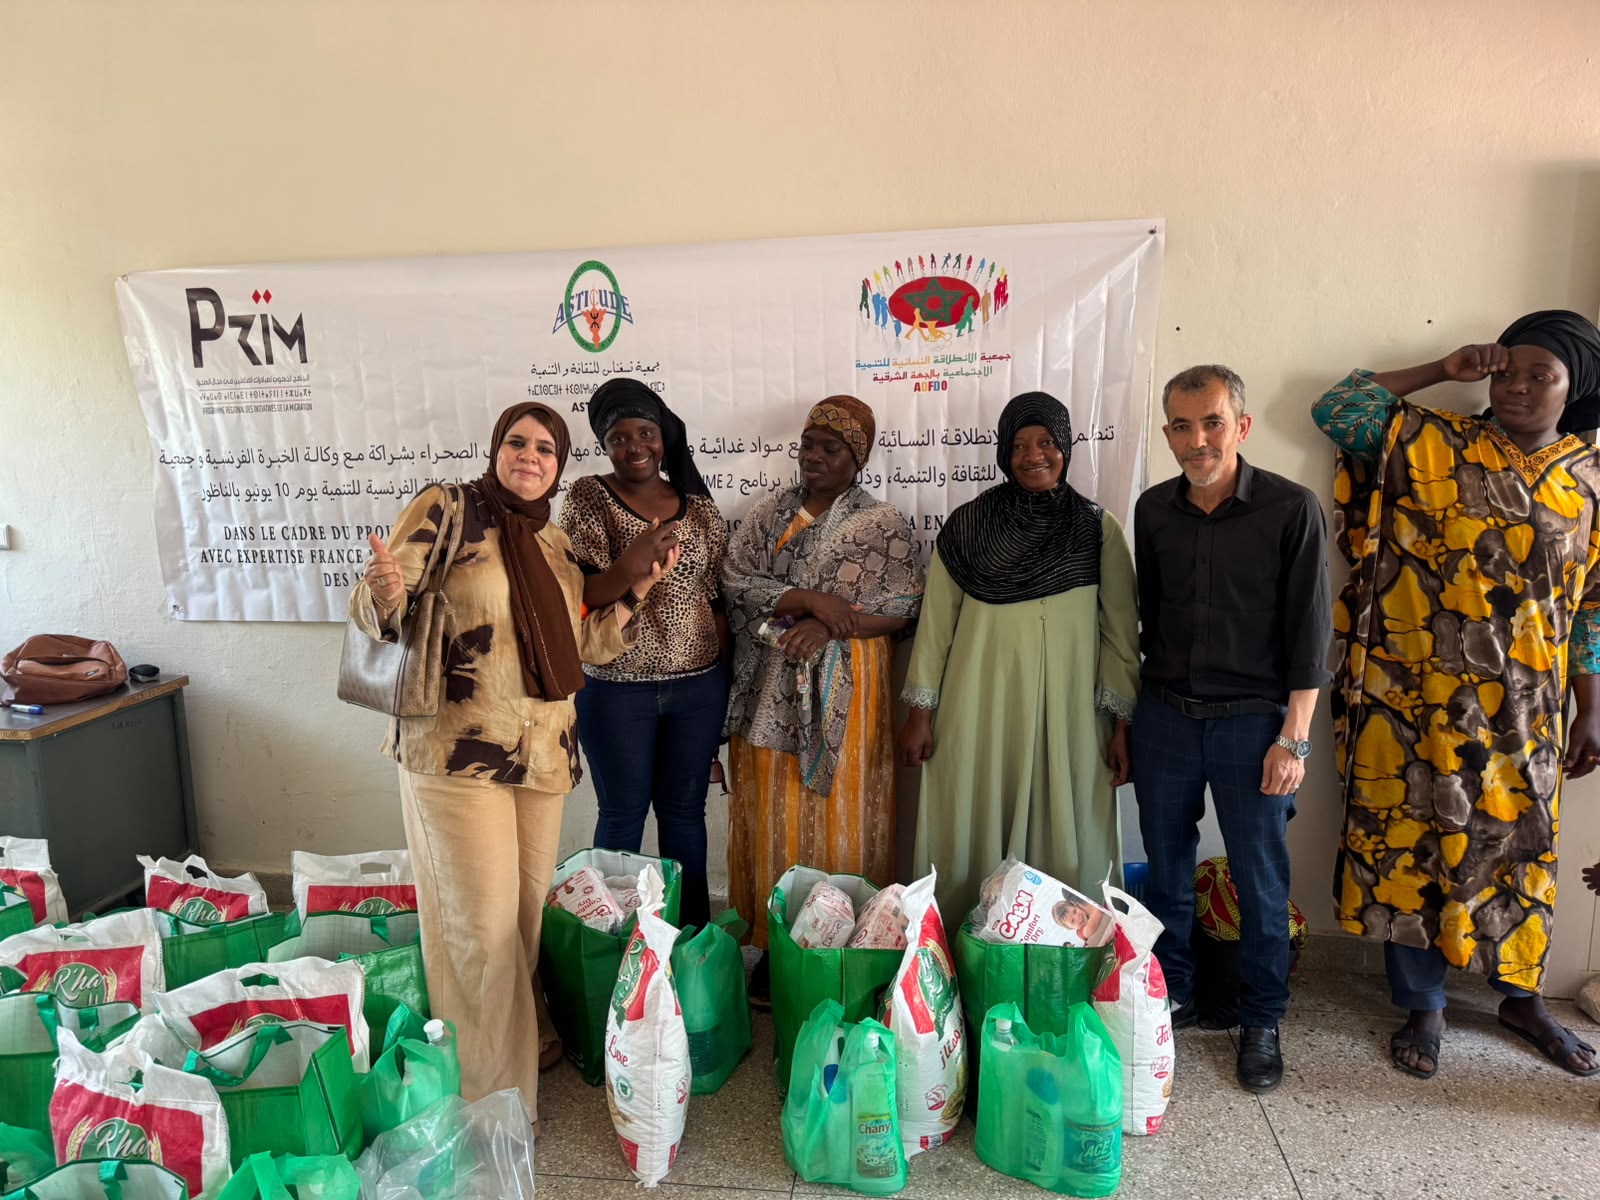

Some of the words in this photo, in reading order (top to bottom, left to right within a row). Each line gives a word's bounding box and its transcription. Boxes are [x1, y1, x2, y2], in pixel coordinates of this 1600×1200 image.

[553, 288, 634, 334] ASTICUDE
[855, 358, 890, 370] للتنمية
[934, 352, 977, 365] الانطلاقة
[980, 352, 1012, 363] جمعية
[531, 362, 561, 379] التنمية
[562, 368, 569, 377] و
[570, 361, 600, 374] للثقافة
[910, 369, 940, 380] بالجهة
[943, 366, 993, 379] الاجتماعية
[873, 371, 908, 384] الشرقية
[750, 436, 784, 458] مواد
[878, 429, 935, 453] النسائية
[159, 450, 195, 469] جمعية
[205, 448, 255, 469] الفرنسية
[258, 447, 299, 469] الخبرة
[304, 445, 339, 466] وكالة
[343, 451, 365, 469] مع
[369, 444, 415, 466] بشراكة
[420, 442, 478, 464] الصحراء
[198, 455, 203, 469] و
[726, 473, 734, 489] 2
[887, 466, 946, 489] والتنمية،
[951, 464, 996, 482] للثقافة
[201, 482, 240, 502] بالناظور
[275, 482, 290, 497] 10
[322, 479, 361, 501] للتنمية
[366, 478, 418, 500] الفرنسية
[740, 471, 781, 496] برنامج
[244, 483, 272, 502] يونيو
[295, 486, 318, 502] يوم
[224, 525, 256, 541] DANS
[261, 525, 276, 541] LE
[281, 525, 327, 541] CADRE
[331, 525, 350, 540] DU
[200, 549, 232, 563] AVEC
[237, 549, 305, 564] EXPERTISE
[310, 549, 364, 563] FRANCE
[324, 572, 349, 587] DES
[1030, 926, 1044, 943] Dry
[858, 1122, 892, 1135] Chany
